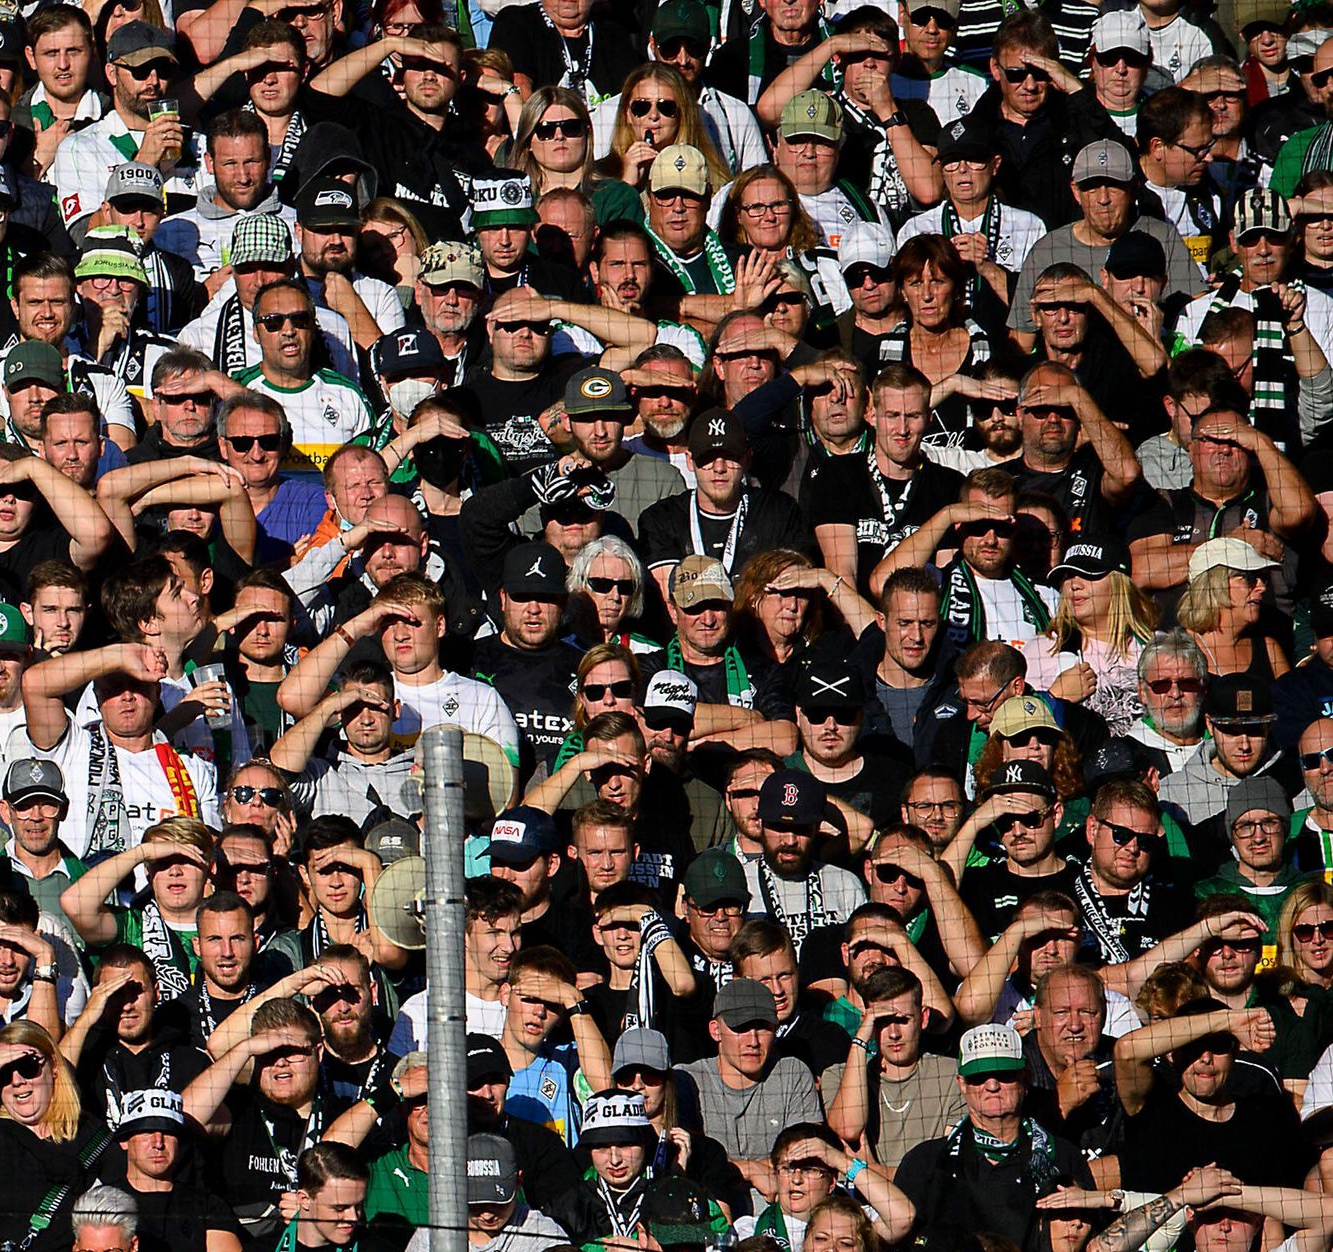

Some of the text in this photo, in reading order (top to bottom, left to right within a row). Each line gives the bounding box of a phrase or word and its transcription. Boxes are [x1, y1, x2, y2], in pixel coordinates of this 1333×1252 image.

[118, 168, 153, 181] 1900
[708, 418, 726, 437] NY
[1005, 763, 1023, 784] NY
[781, 783, 800, 807] B
[495, 826, 520, 838] NASA
[247, 1154, 282, 1175] FOHLEN
[466, 1159, 502, 1178] BORUSSIA
